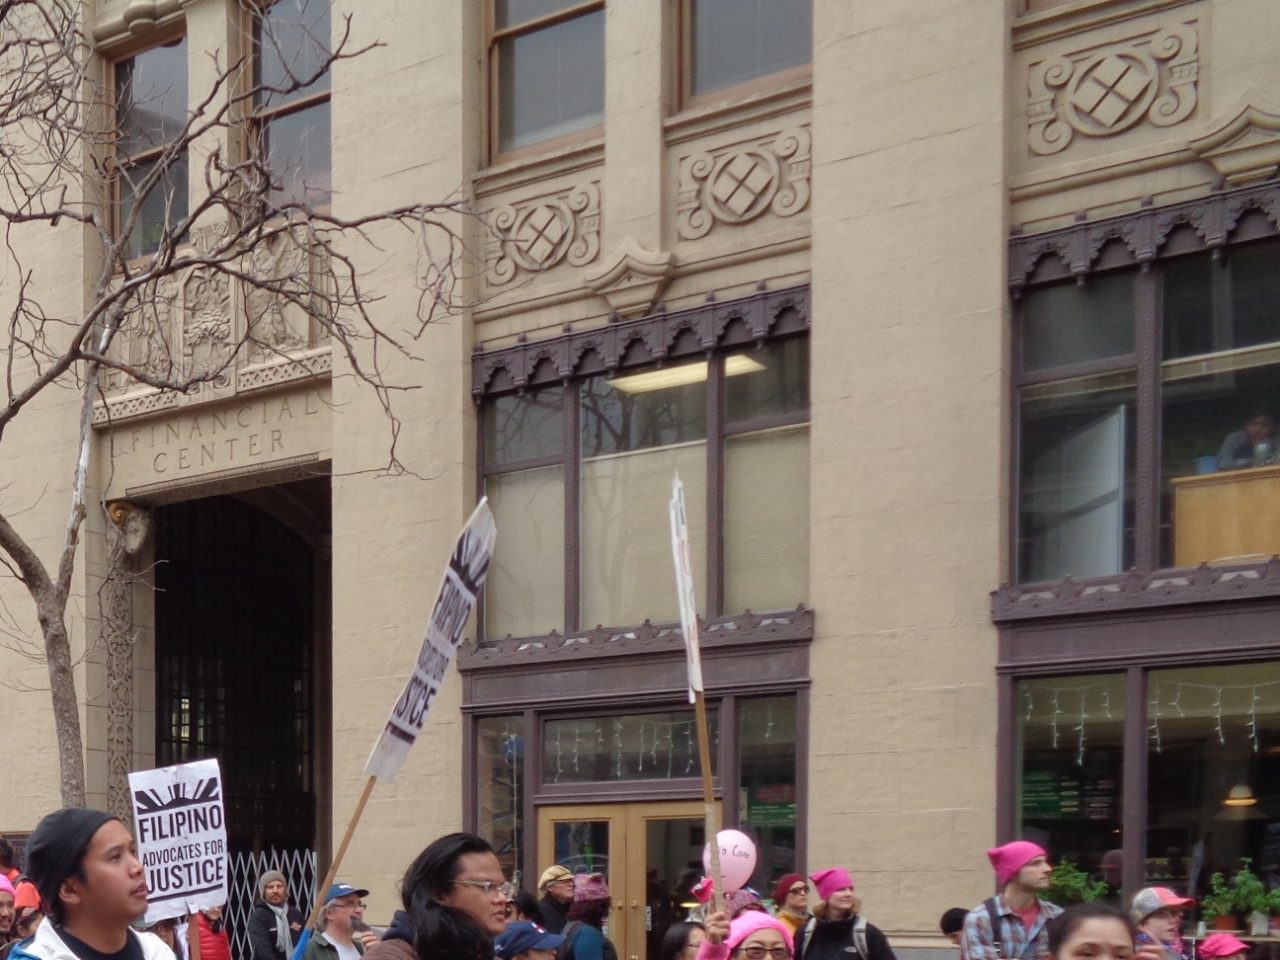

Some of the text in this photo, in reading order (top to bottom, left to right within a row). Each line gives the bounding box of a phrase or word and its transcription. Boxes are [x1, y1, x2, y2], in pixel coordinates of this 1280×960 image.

[131, 393, 318, 451] FINANCIAL
[153, 429, 284, 473] CENTER
[137, 804, 222, 843] FILIPINO
[142, 840, 223, 867] ADVOCATES FOR
[147, 856, 223, 892] JUSTICE
